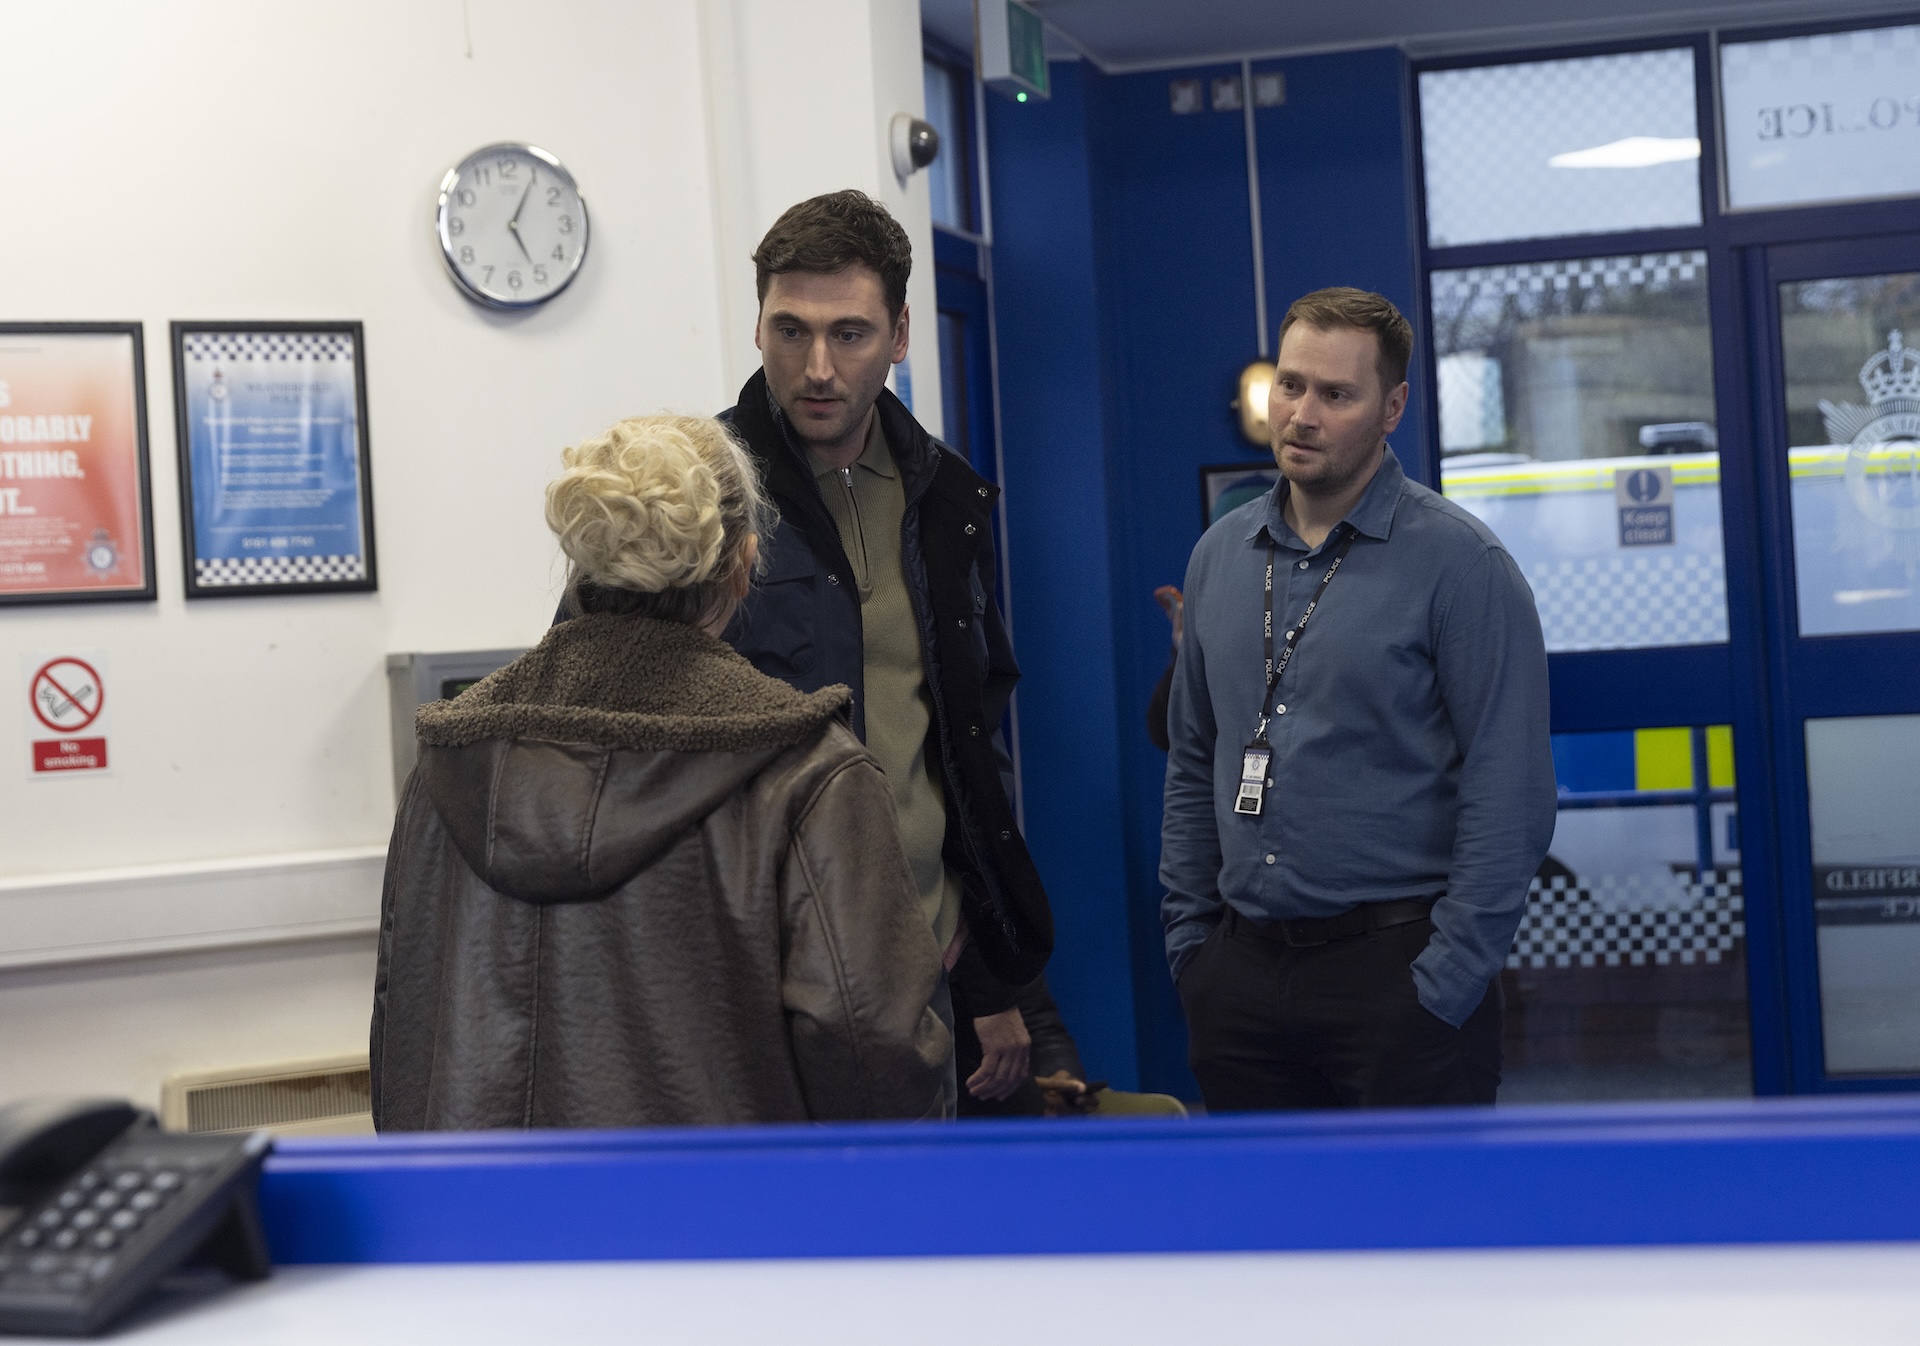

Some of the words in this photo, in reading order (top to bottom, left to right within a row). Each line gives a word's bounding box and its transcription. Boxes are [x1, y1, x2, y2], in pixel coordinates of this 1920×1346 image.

[473, 166, 490, 186] 11
[497, 159, 518, 179] 12
[457, 188, 476, 208] 10
[547, 186, 562, 206] 2
[450, 216, 465, 236] 9
[558, 215, 573, 234] 3
[460, 245, 475, 266] 8
[551, 243, 564, 262] 4
[481, 265, 495, 285] 7
[507, 269, 523, 291] 6
[532, 263, 548, 283] 5
[1623, 510, 1668, 527] Keep
[1624, 528, 1667, 543] clear
[1265, 564, 1273, 591] POLICE
[1323, 556, 1342, 583] POLICE
[1264, 611, 1272, 638] POLICE
[1298, 601, 1317, 628] POLICE
[1276, 646, 1294, 674] POLICE
[60, 741, 80, 753] No
[44, 754, 97, 769] smoking
